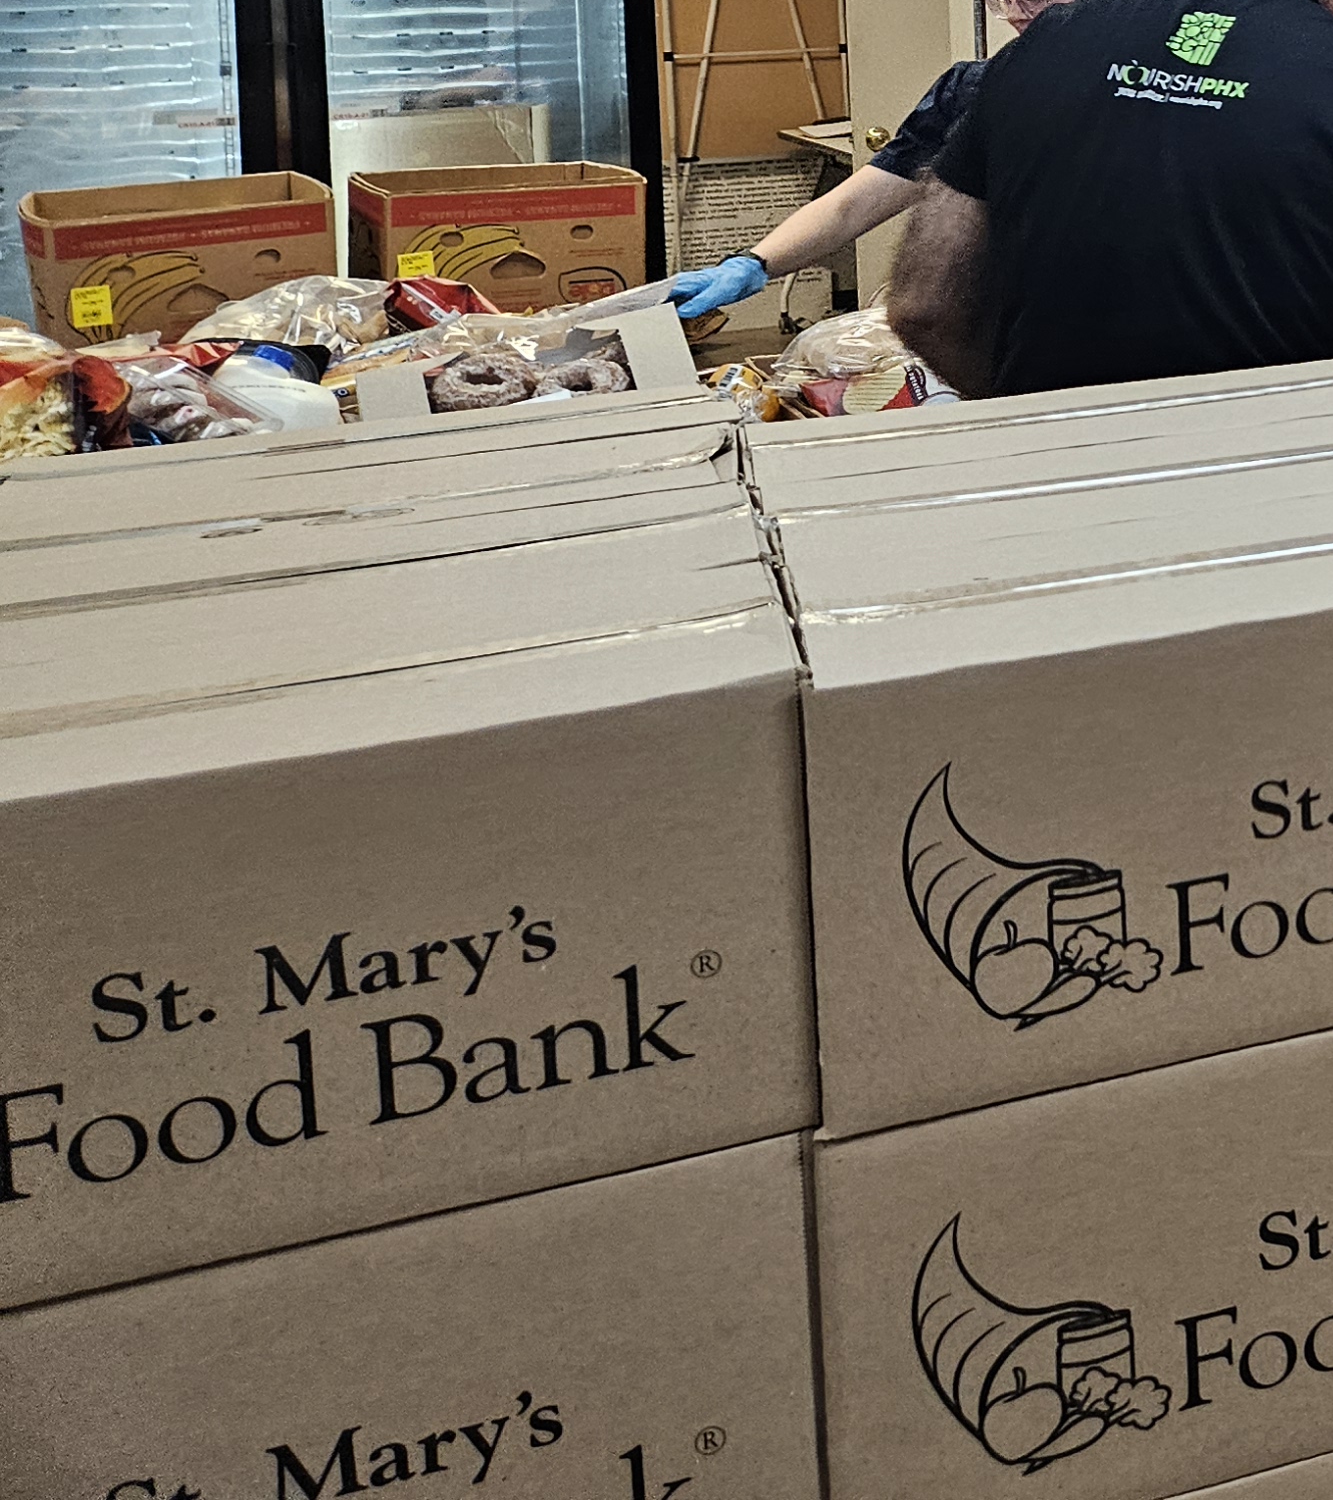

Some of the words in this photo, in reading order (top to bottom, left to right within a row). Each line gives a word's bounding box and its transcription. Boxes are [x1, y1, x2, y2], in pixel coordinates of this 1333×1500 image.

[91, 971, 217, 1043] St.
[254, 905, 557, 1016] Mary's
[0, 1028, 327, 1204] Food
[360, 964, 695, 1126] Bank
[266, 1390, 564, 1500] Mary's
